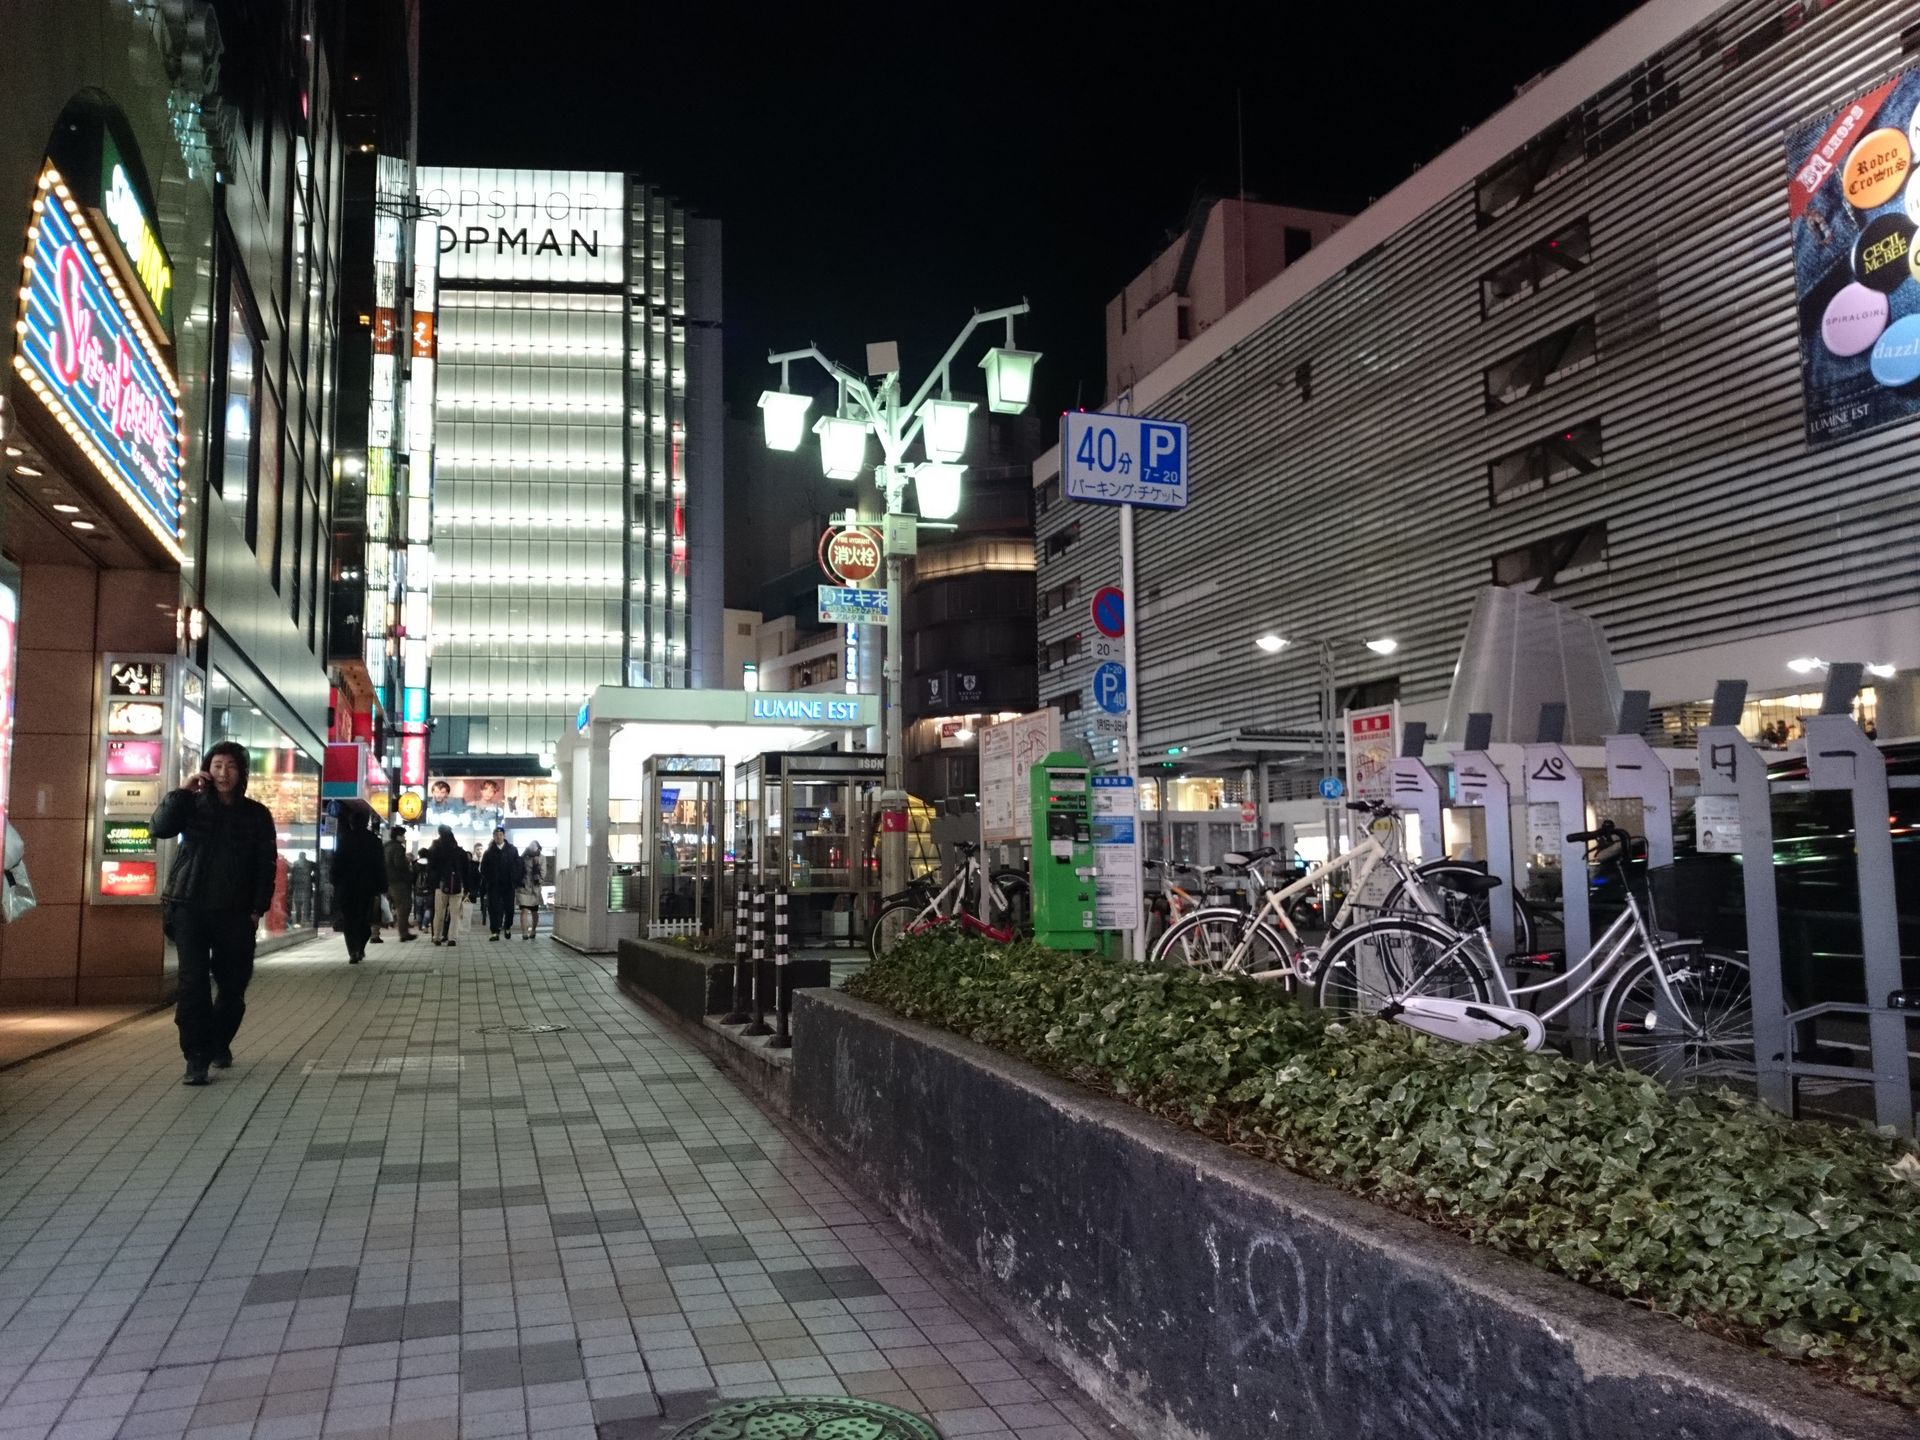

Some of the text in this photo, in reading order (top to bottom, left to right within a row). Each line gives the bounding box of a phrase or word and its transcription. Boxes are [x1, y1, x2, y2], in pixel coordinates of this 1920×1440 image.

[1822, 104, 1864, 159] SHOPS
[417, 188, 599, 220] OPSHOP
[439, 225, 599, 258] OPMAN
[1863, 231, 1900, 261] CECIL
[1825, 309, 1887, 326] SPIRALGIRL
[1873, 337, 1920, 359] dazzl
[1810, 403, 1869, 433] LUMINE EST
[1076, 425, 1132, 475] 40分
[1149, 428, 1176, 468] P
[834, 545, 875, 567] 消火栓
[1102, 673, 1118, 706] P
[754, 699, 858, 720] LUMINE EST
[858, 759, 884, 769] ISDN
[107, 829, 149, 839] SUBWAY
